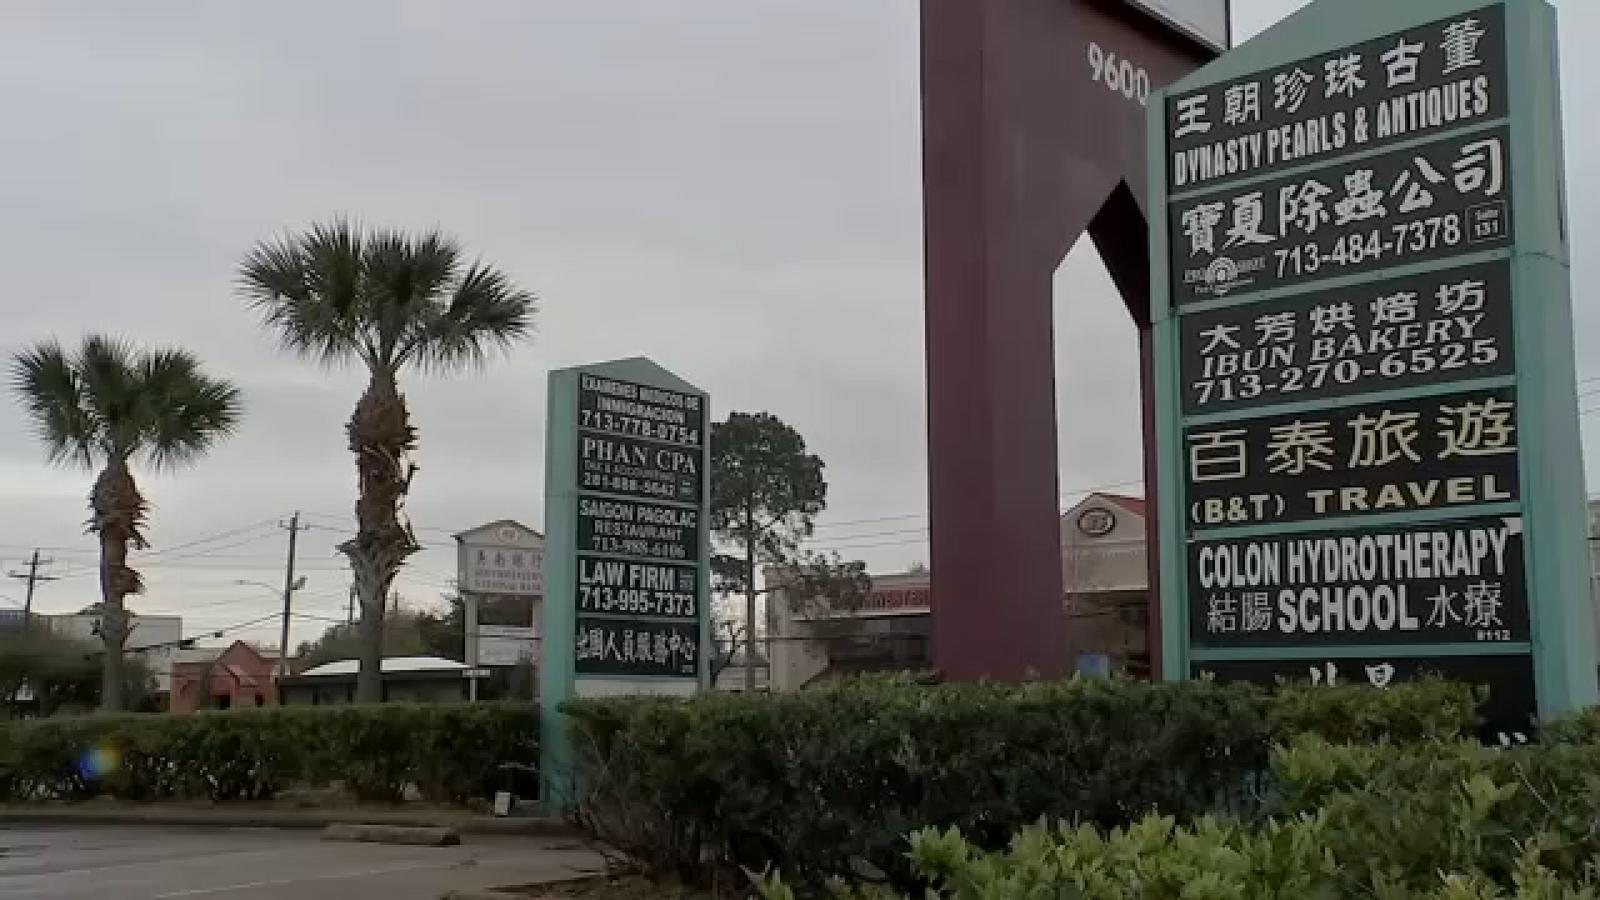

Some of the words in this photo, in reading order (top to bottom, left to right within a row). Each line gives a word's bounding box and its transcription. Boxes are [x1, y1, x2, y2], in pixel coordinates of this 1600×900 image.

[1088, 41, 1149, 106] 9600
[1174, 18, 1486, 138] 王朝珍珠古董
[1174, 131, 1261, 186] DYNASTY
[1266, 111, 1346, 164] PEARLS
[1354, 106, 1368, 144] &
[1376, 75, 1488, 139] ANTIQUES
[1274, 213, 1461, 279] 713-484-7378
[1199, 279, 1487, 355] 大芳烘焙坊
[1203, 344, 1296, 379] IBUN
[1311, 312, 1485, 362] BAKERY
[1193, 337, 1499, 405] 713-270-6525
[582, 437, 649, 467] PHAN
[657, 449, 696, 474] CPA
[1187, 396, 1518, 482] 百泰旅遊
[580, 499, 633, 521] SAIGON
[1191, 494, 1286, 523] (B&T)
[1307, 474, 1511, 514] TRAVEL
[579, 558, 626, 587] LAW
[629, 563, 675, 591] FIRM
[1200, 541, 1280, 588] COLON
[1289, 527, 1508, 583] HYDROTHERAPY
[579, 585, 695, 616] 713-995-7373
[1277, 584, 1420, 633] SCHOOL
